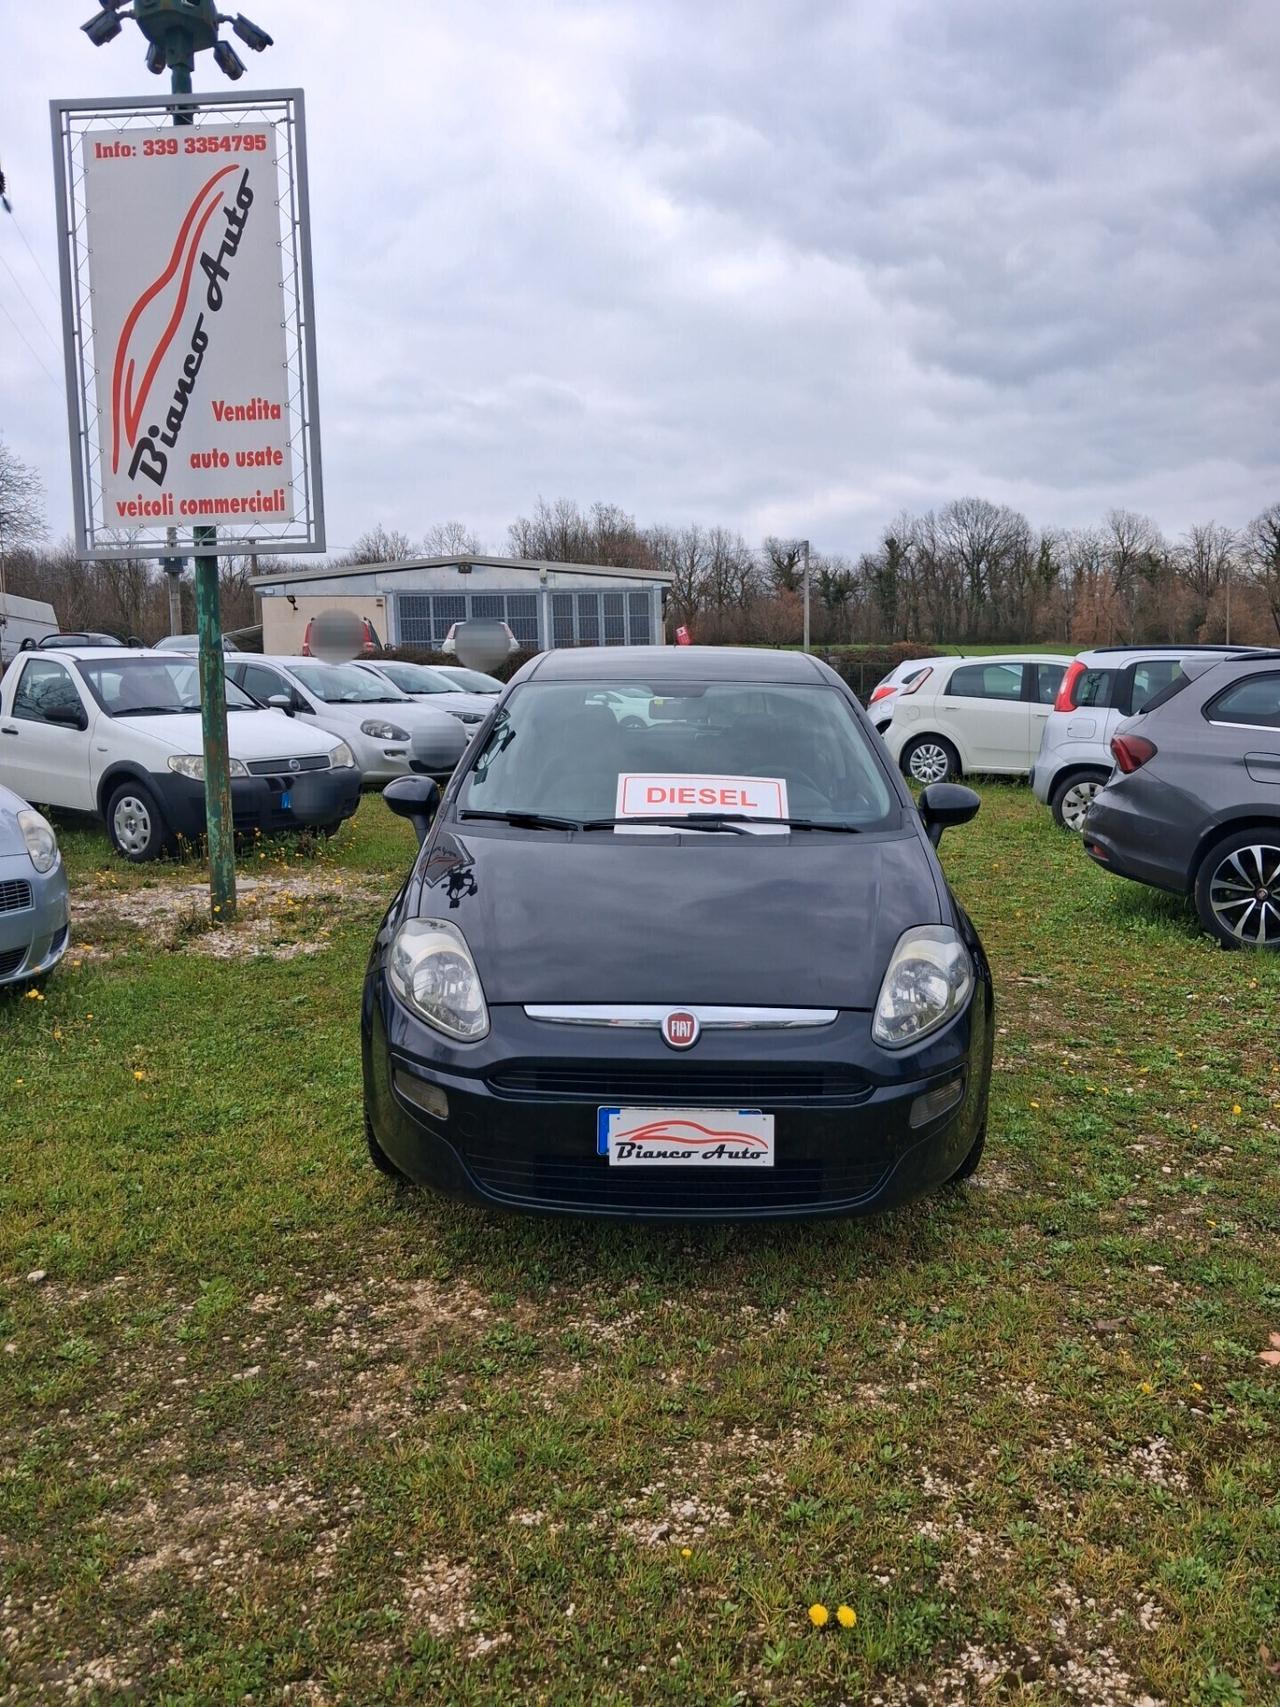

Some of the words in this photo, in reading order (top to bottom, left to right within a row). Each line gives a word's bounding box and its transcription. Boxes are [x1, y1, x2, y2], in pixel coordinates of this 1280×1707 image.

[95, 143, 137, 159] Info:
[143, 139, 179, 157] 339
[184, 134, 267, 155] 3354795
[127, 312, 210, 487] Bianco
[200, 167, 255, 312] Auto
[211, 399, 281, 422] Vendita
[190, 450, 230, 469] auto
[235, 447, 284, 468] usate
[116, 494, 174, 517] veicoli
[179, 489, 286, 515] commerciali
[646, 787, 758, 807] DIESEL
[671, 1020, 692, 1038] FIAT
[615, 1141, 699, 1159] Bianco
[702, 1144, 768, 1160] Auto
